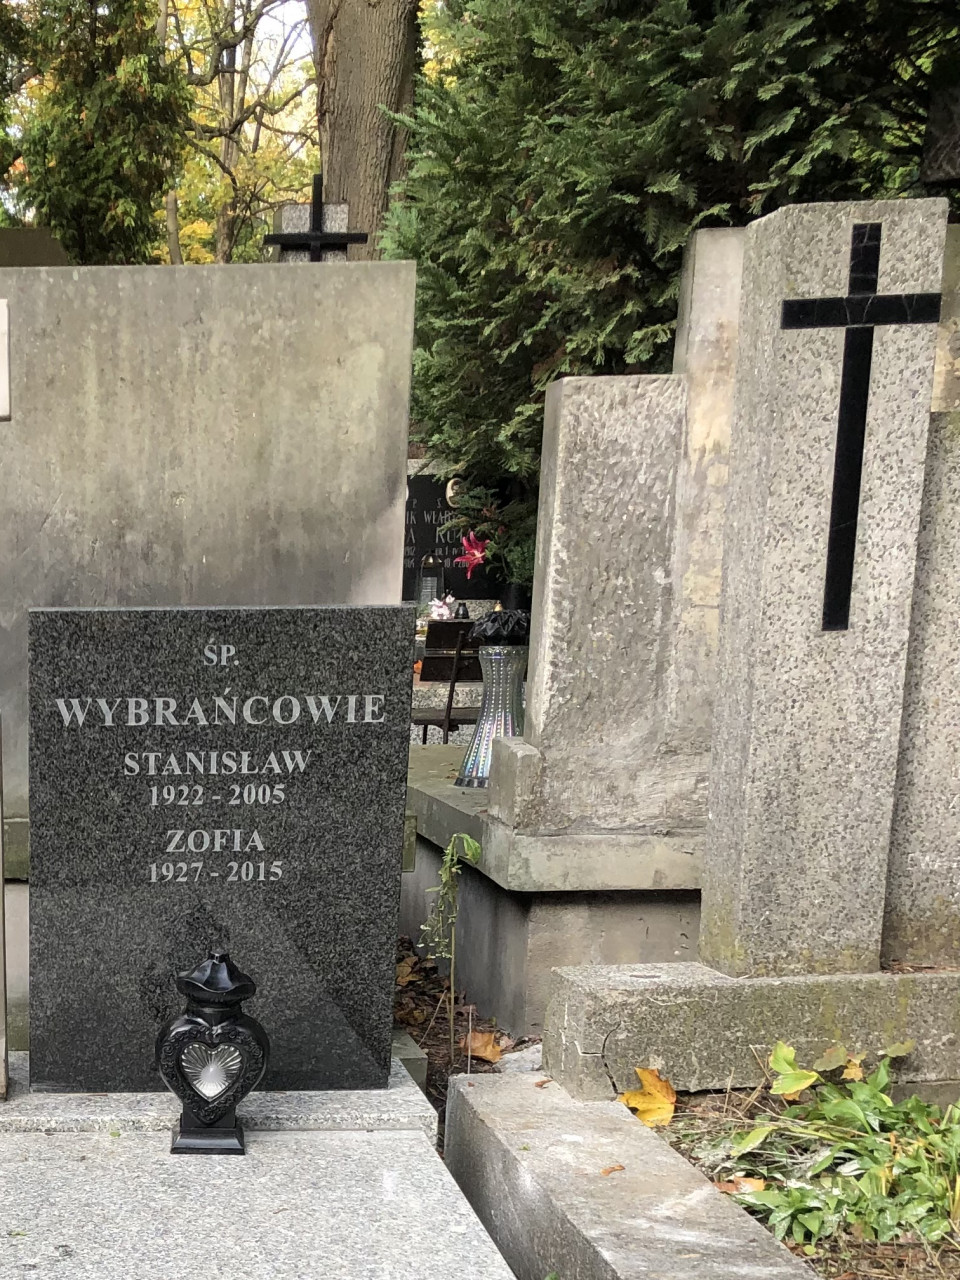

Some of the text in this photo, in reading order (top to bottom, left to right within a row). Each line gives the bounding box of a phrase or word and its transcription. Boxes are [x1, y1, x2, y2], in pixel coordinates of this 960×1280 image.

[203, 638, 240, 667] ŚP.
[55, 687, 386, 727] WYBRAŃCOWIE
[123, 750, 313, 776] STANISŁAW
[148, 785, 204, 806] 1922
[228, 783, 286, 805] 2005
[166, 829, 266, 853] ZOFIA
[148, 861, 203, 883] 1927
[227, 860, 284, 882] 2015
